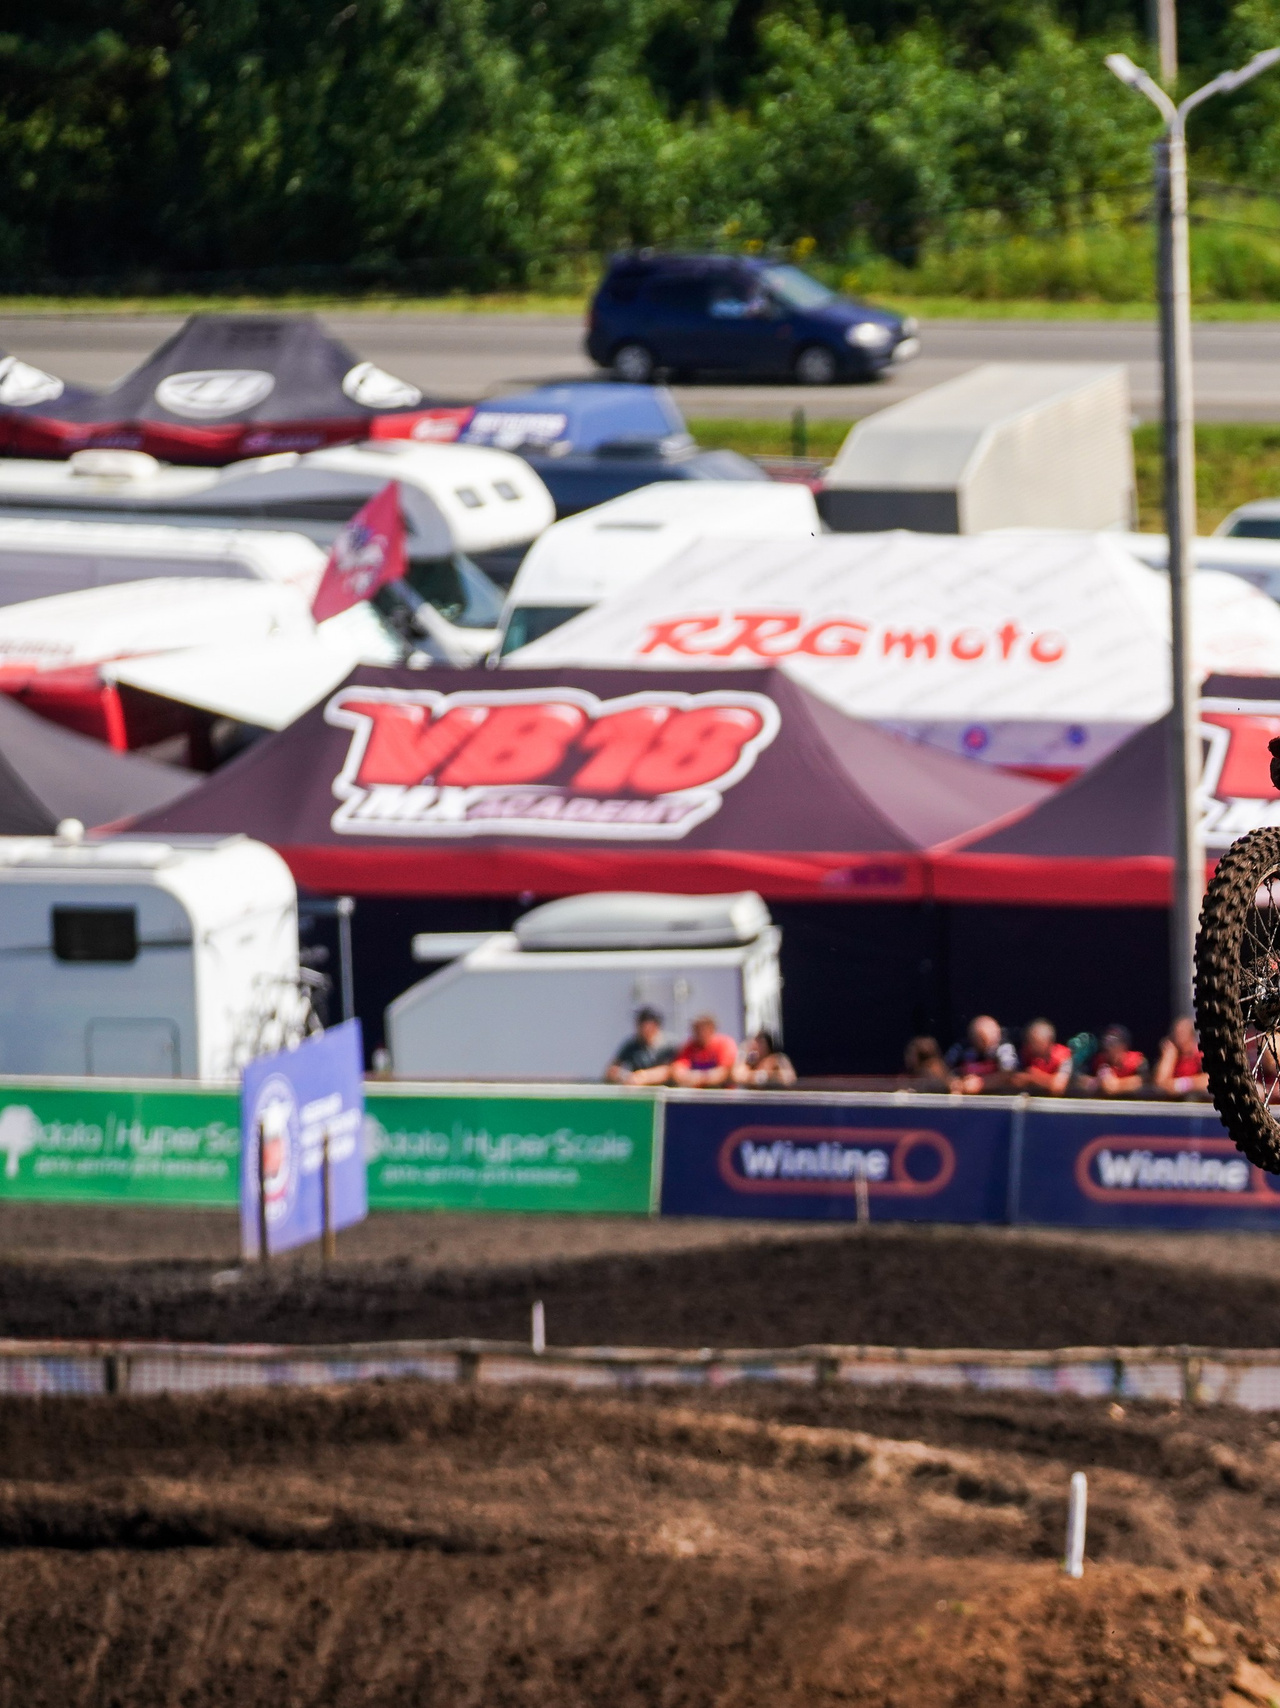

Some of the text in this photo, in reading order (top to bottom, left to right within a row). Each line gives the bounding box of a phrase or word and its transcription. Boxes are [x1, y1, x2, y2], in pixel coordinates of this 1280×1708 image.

[640, 613, 1066, 663] RRG moto
[340, 701, 764, 795] VB18
[740, 1139, 889, 1181] Winline
[1097, 1149, 1249, 1192] Winline
